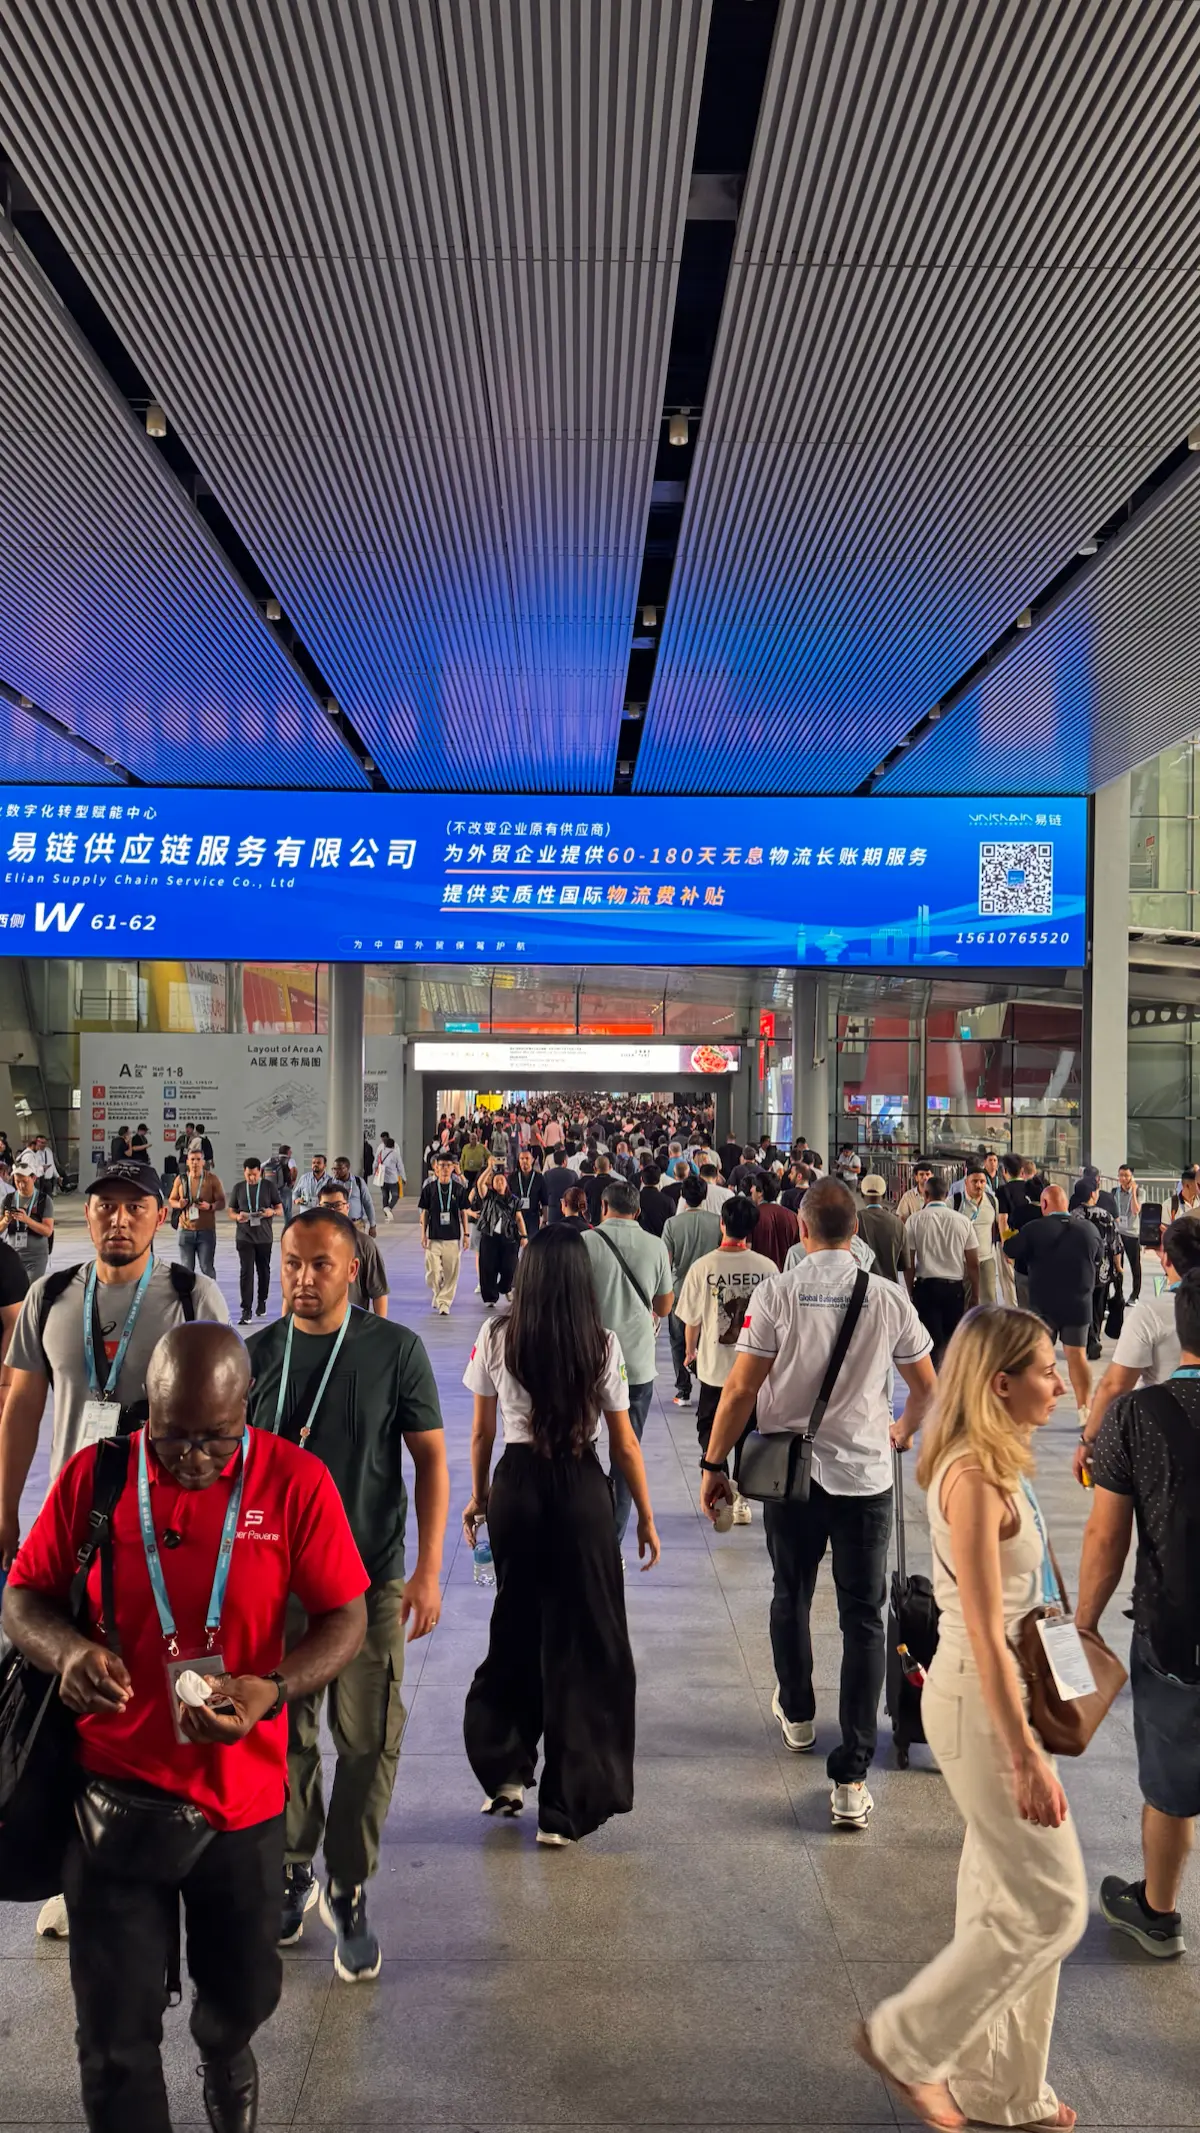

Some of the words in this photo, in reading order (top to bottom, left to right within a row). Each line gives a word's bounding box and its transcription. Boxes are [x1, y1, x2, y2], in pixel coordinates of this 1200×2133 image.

[0, 803, 157, 820] 数字化转型赋能中心
[1035, 814, 1062, 826] 易链
[446, 820, 611, 837] (不改变企业原有供应商)
[6, 831, 417, 870] 易链供应链服务有限公司
[443, 843, 927, 867] 为外贸企业提供60-180天无息物流长账期服务
[5, 872, 45, 883] Elian
[53, 873, 106, 887] Supply
[114, 874, 158, 885] Chain
[166, 875, 225, 887] Service
[232, 877, 262, 889] Co.,
[271, 878, 295, 888] Ltd
[441, 883, 726, 907] 提供实质性国际物流费补贴
[34, 902, 85, 933] W
[90, 914, 157, 931] 61-62
[956, 932, 1069, 944] 15610765520
[247, 1045, 279, 1054] Layout
[281, 1045, 291, 1053] of
[292, 1045, 314, 1053] Area
[316, 1045, 323, 1053] A
[119, 1063, 132, 1077] A
[250, 1057, 321, 1067] A区展区布局图
[166, 1067, 183, 1077] 1-8
